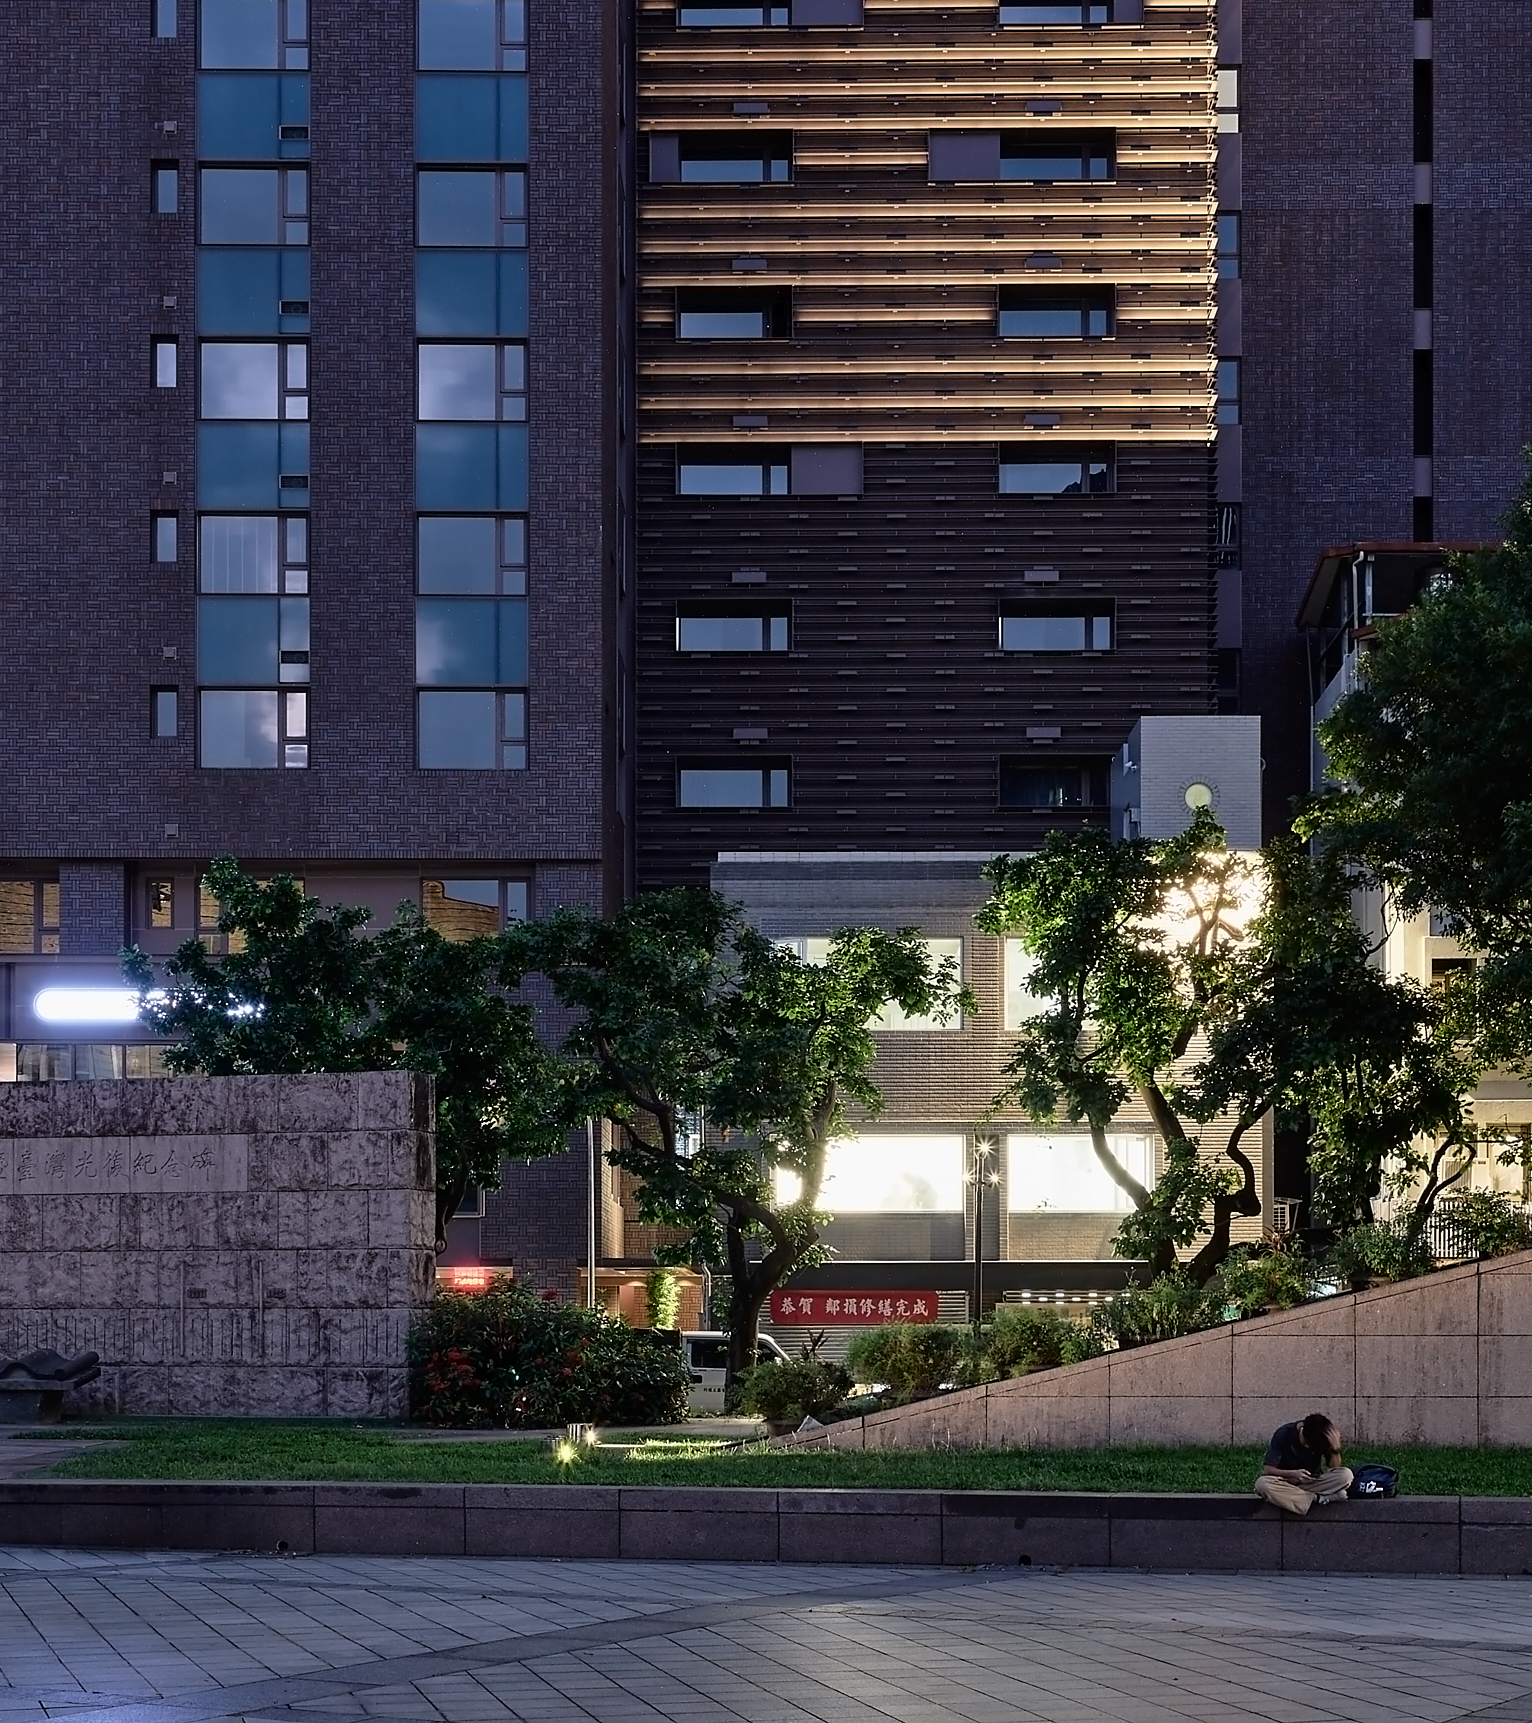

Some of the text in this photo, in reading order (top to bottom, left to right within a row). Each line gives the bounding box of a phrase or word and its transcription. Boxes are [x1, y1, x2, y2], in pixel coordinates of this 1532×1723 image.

[780, 1296, 929, 1317] 恭賀 鄰損修繕完成
